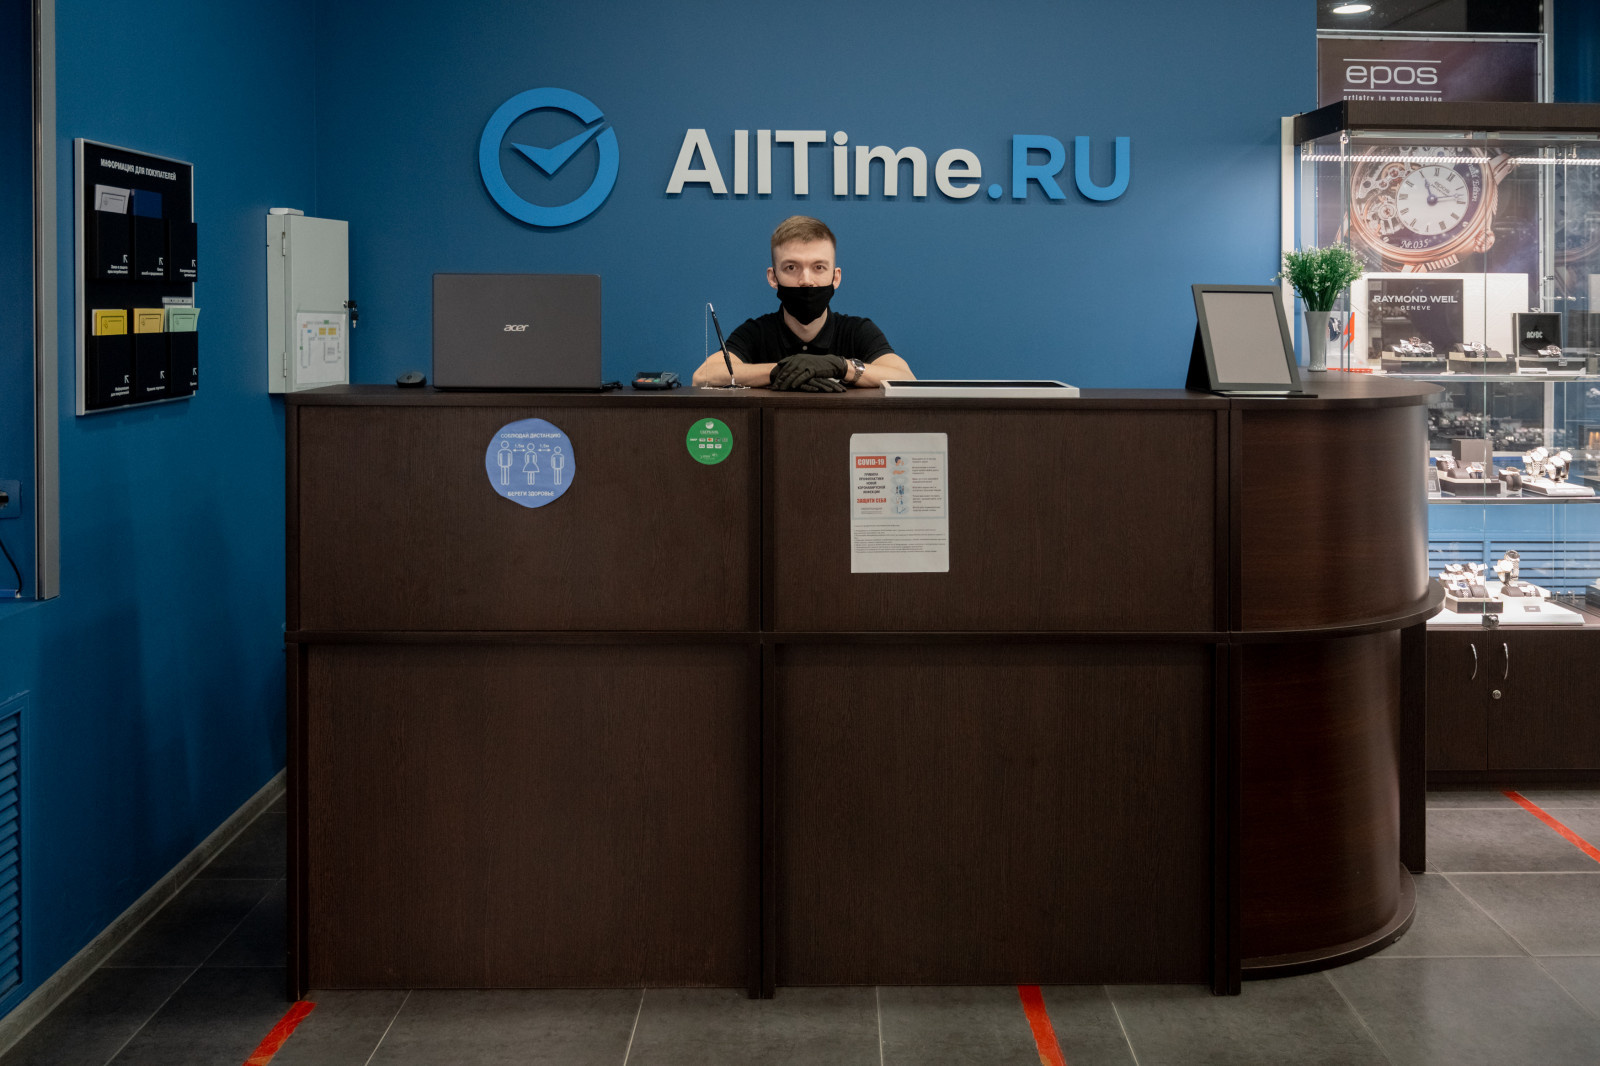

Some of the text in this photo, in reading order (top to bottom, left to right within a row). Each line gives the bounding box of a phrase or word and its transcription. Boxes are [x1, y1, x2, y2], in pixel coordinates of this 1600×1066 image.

[1346, 65, 1438, 89] epos
[100, 158, 177, 181] ИНФОРМАЦИЯ ДЛЯ ПОКУПАТЕЛЕЙ
[665, 128, 1131, 201] AllTime.RU
[1373, 295, 1458, 304] RAYMOND WEIL
[503, 324, 530, 332] acer
[857, 458, 885, 466] COVID-19
